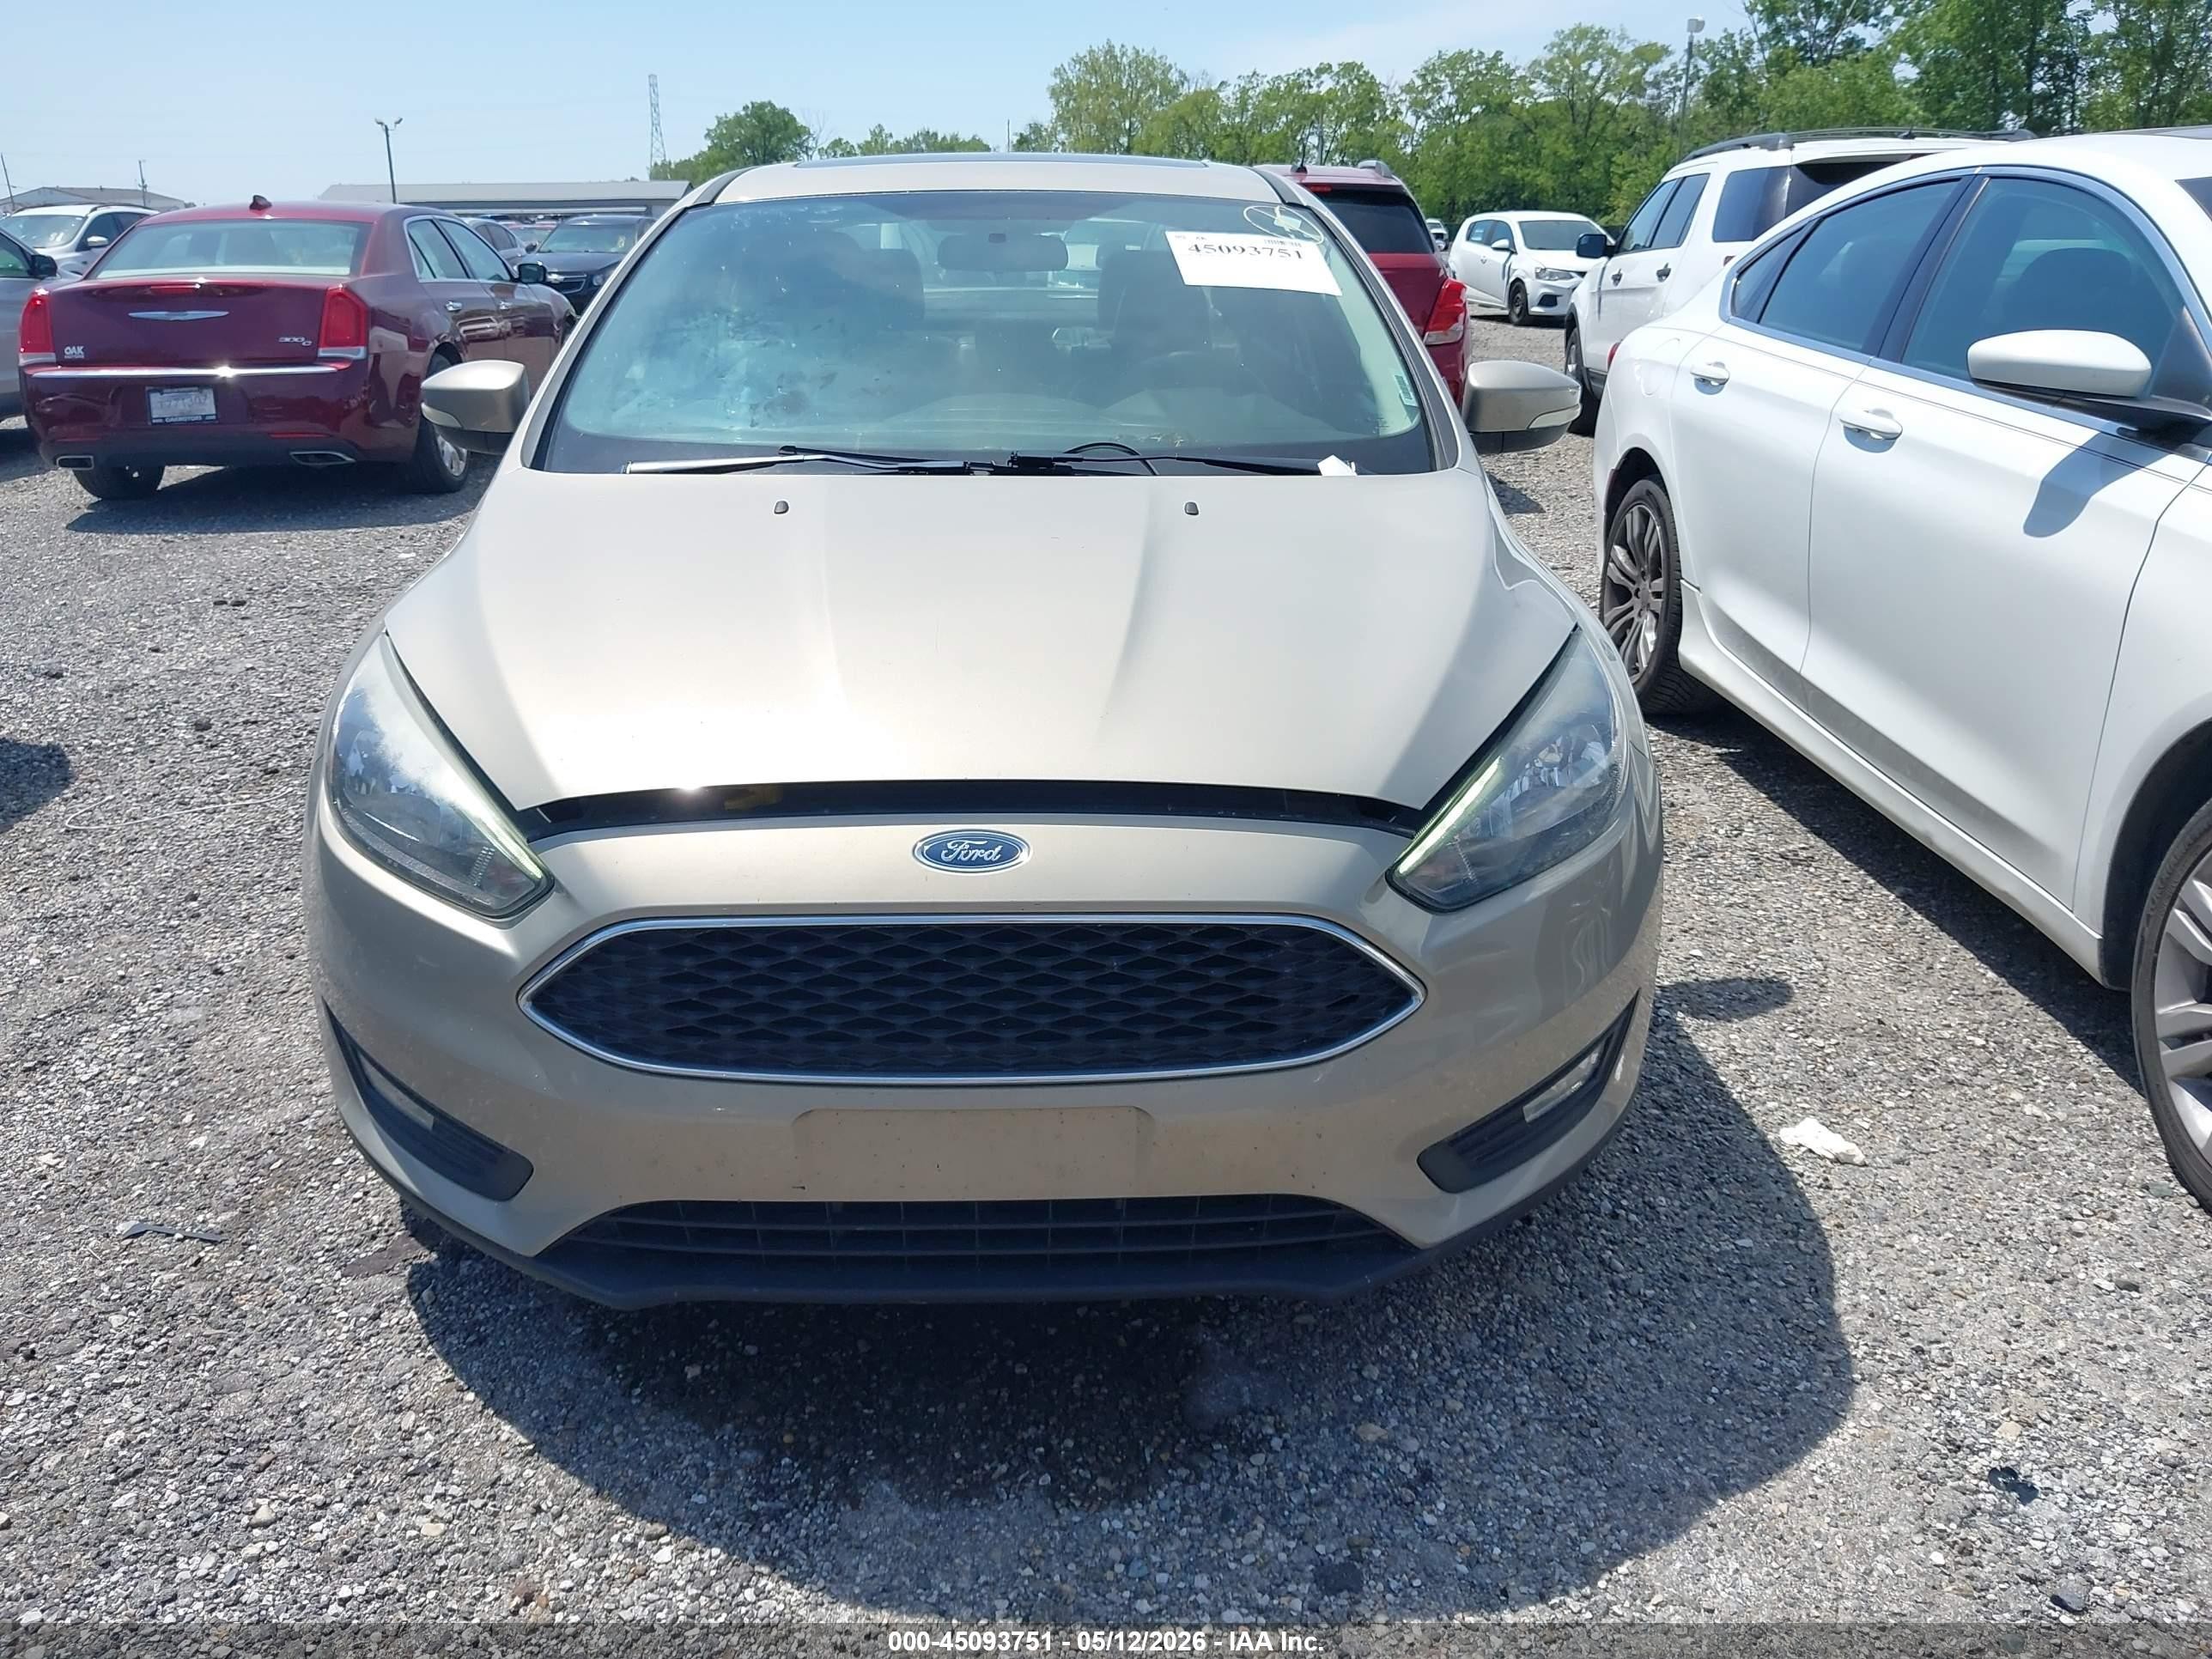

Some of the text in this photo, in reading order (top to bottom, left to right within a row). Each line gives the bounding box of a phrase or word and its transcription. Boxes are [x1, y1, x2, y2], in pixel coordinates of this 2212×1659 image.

[1188, 243, 1303, 260] 45093751
[64, 345, 84, 356] OAK
[940, 840, 1004, 862] Ford
